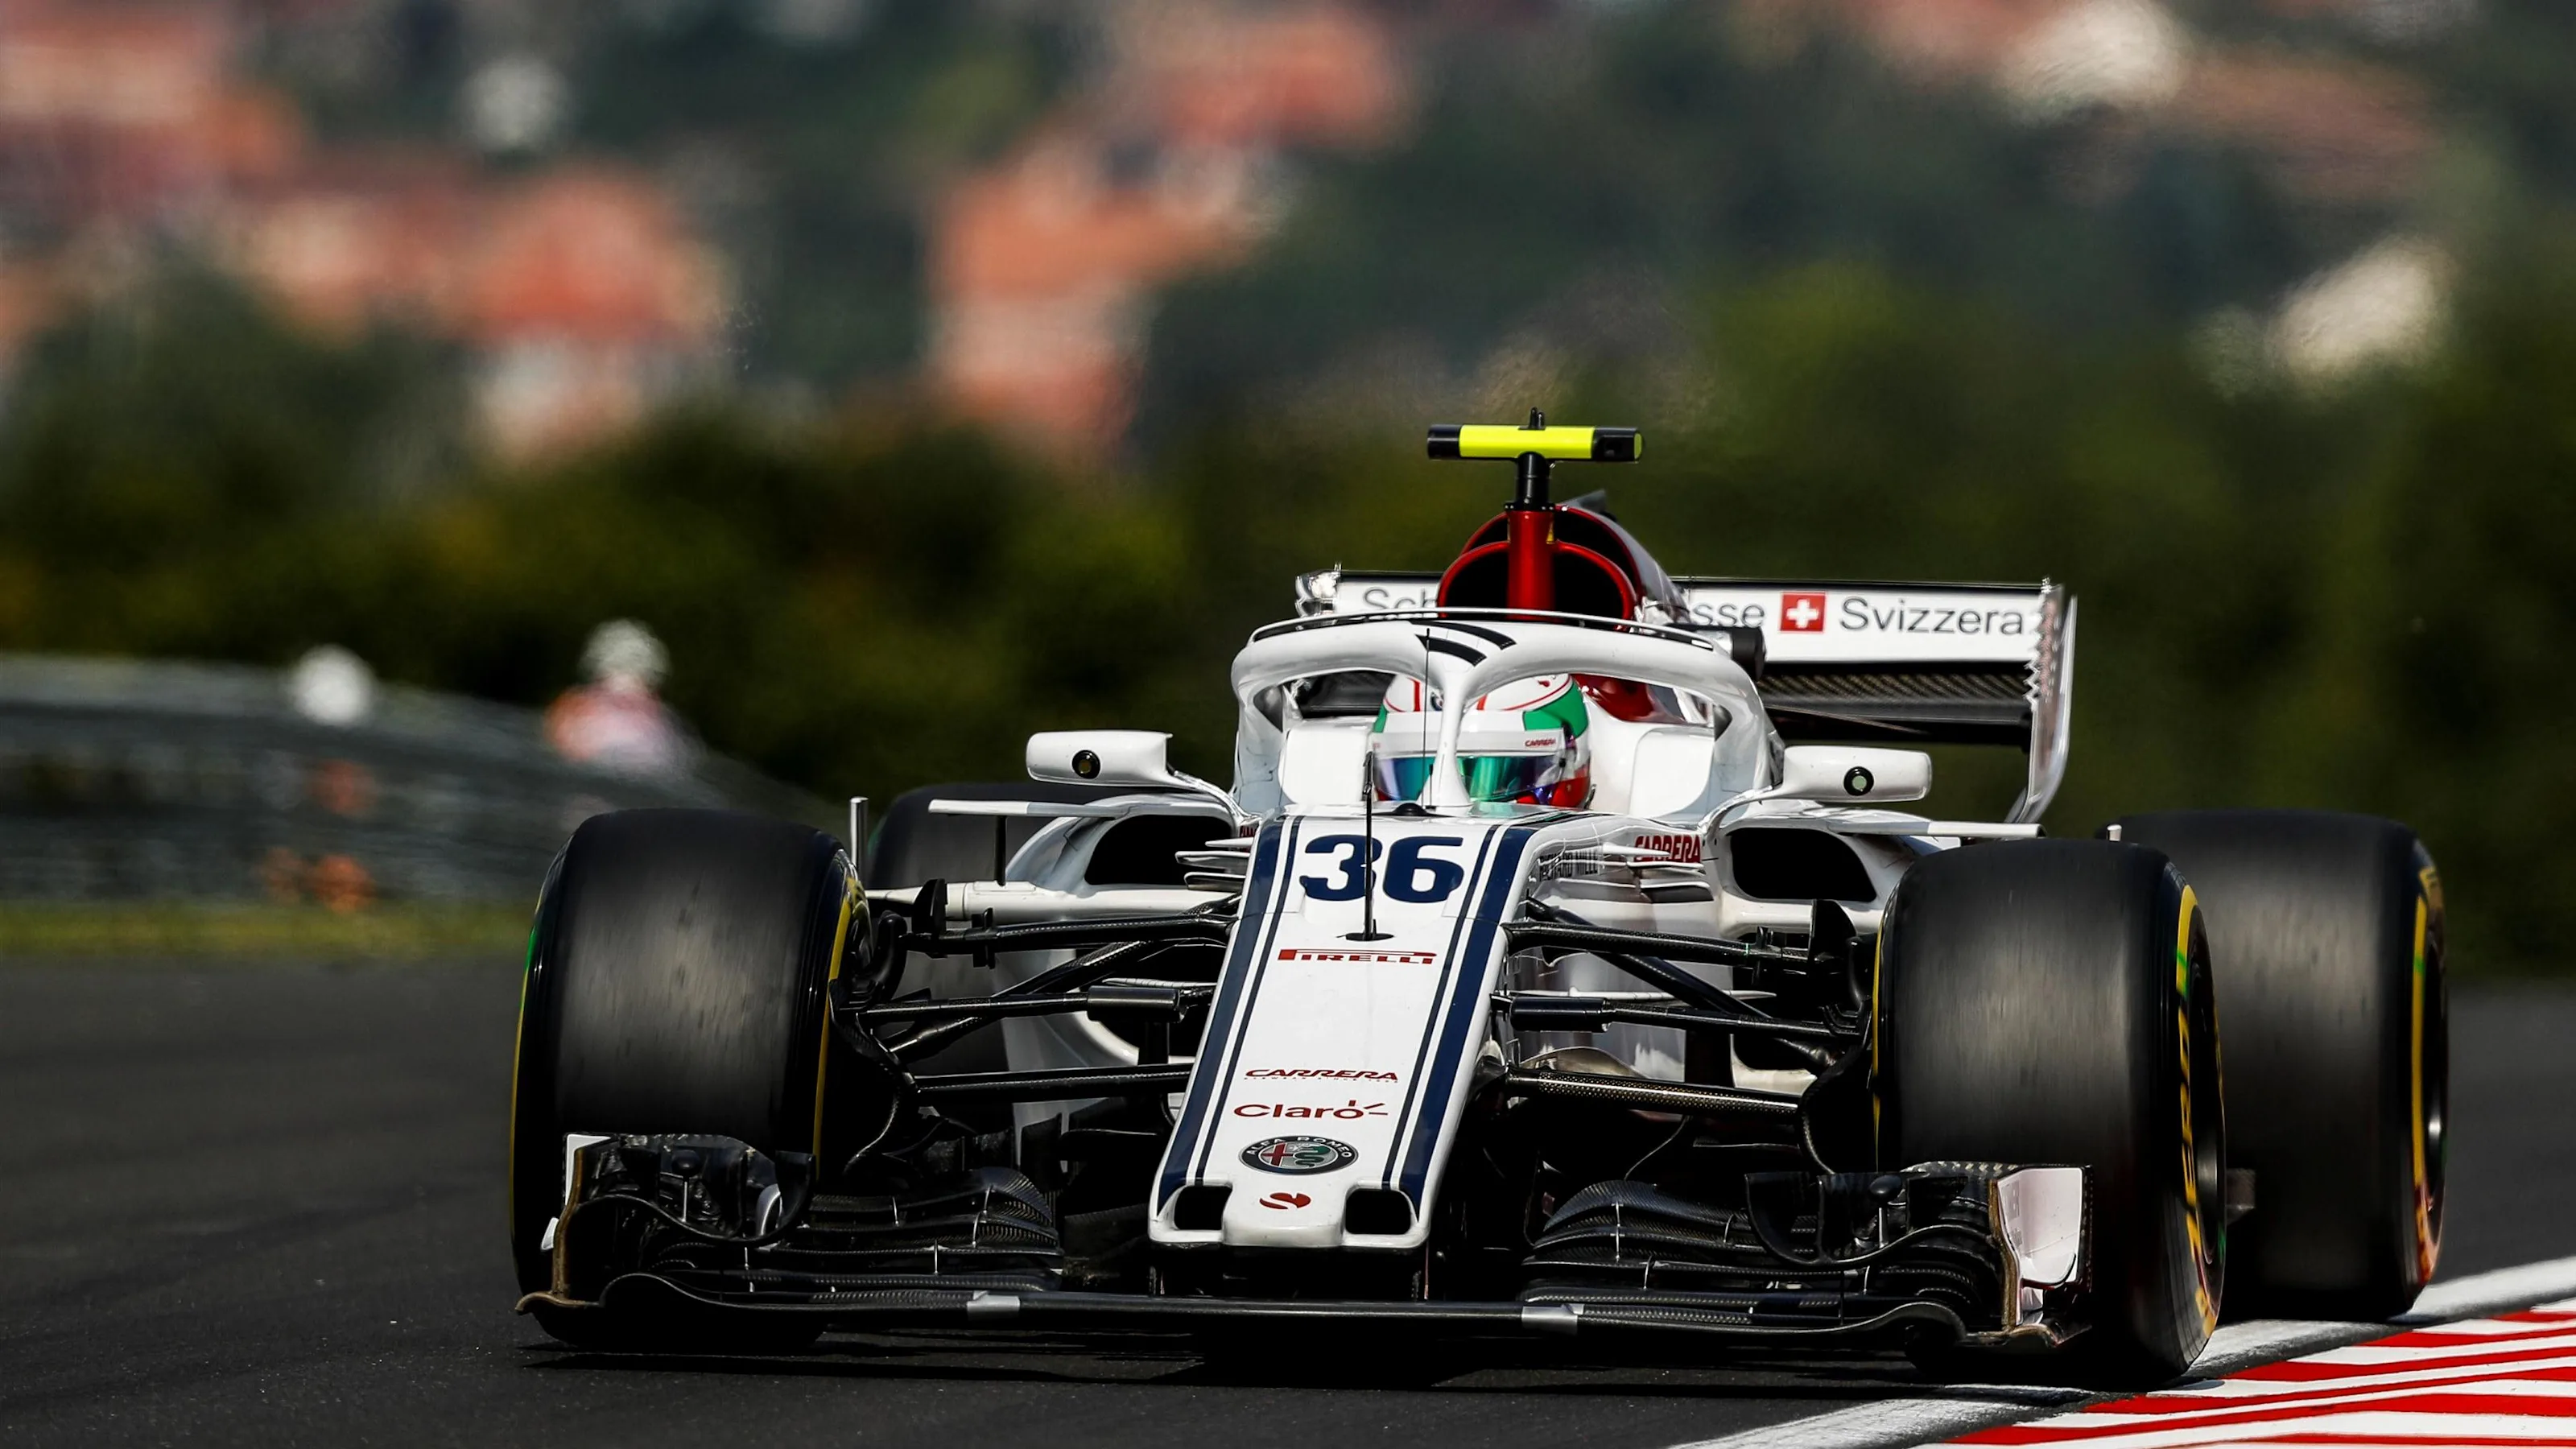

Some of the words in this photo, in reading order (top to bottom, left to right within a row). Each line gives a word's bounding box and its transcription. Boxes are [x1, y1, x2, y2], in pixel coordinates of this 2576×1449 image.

[1840, 596, 2023, 634] Svizzera
[1299, 834, 1464, 903] 36
[1278, 948, 1437, 964] PIRELLI
[1245, 1069, 1398, 1080] CARRERA
[1233, 1100, 1365, 1119] Claro
[1246, 1138, 1286, 1155] ALFA
[1297, 1137, 1352, 1158] ROMEO
